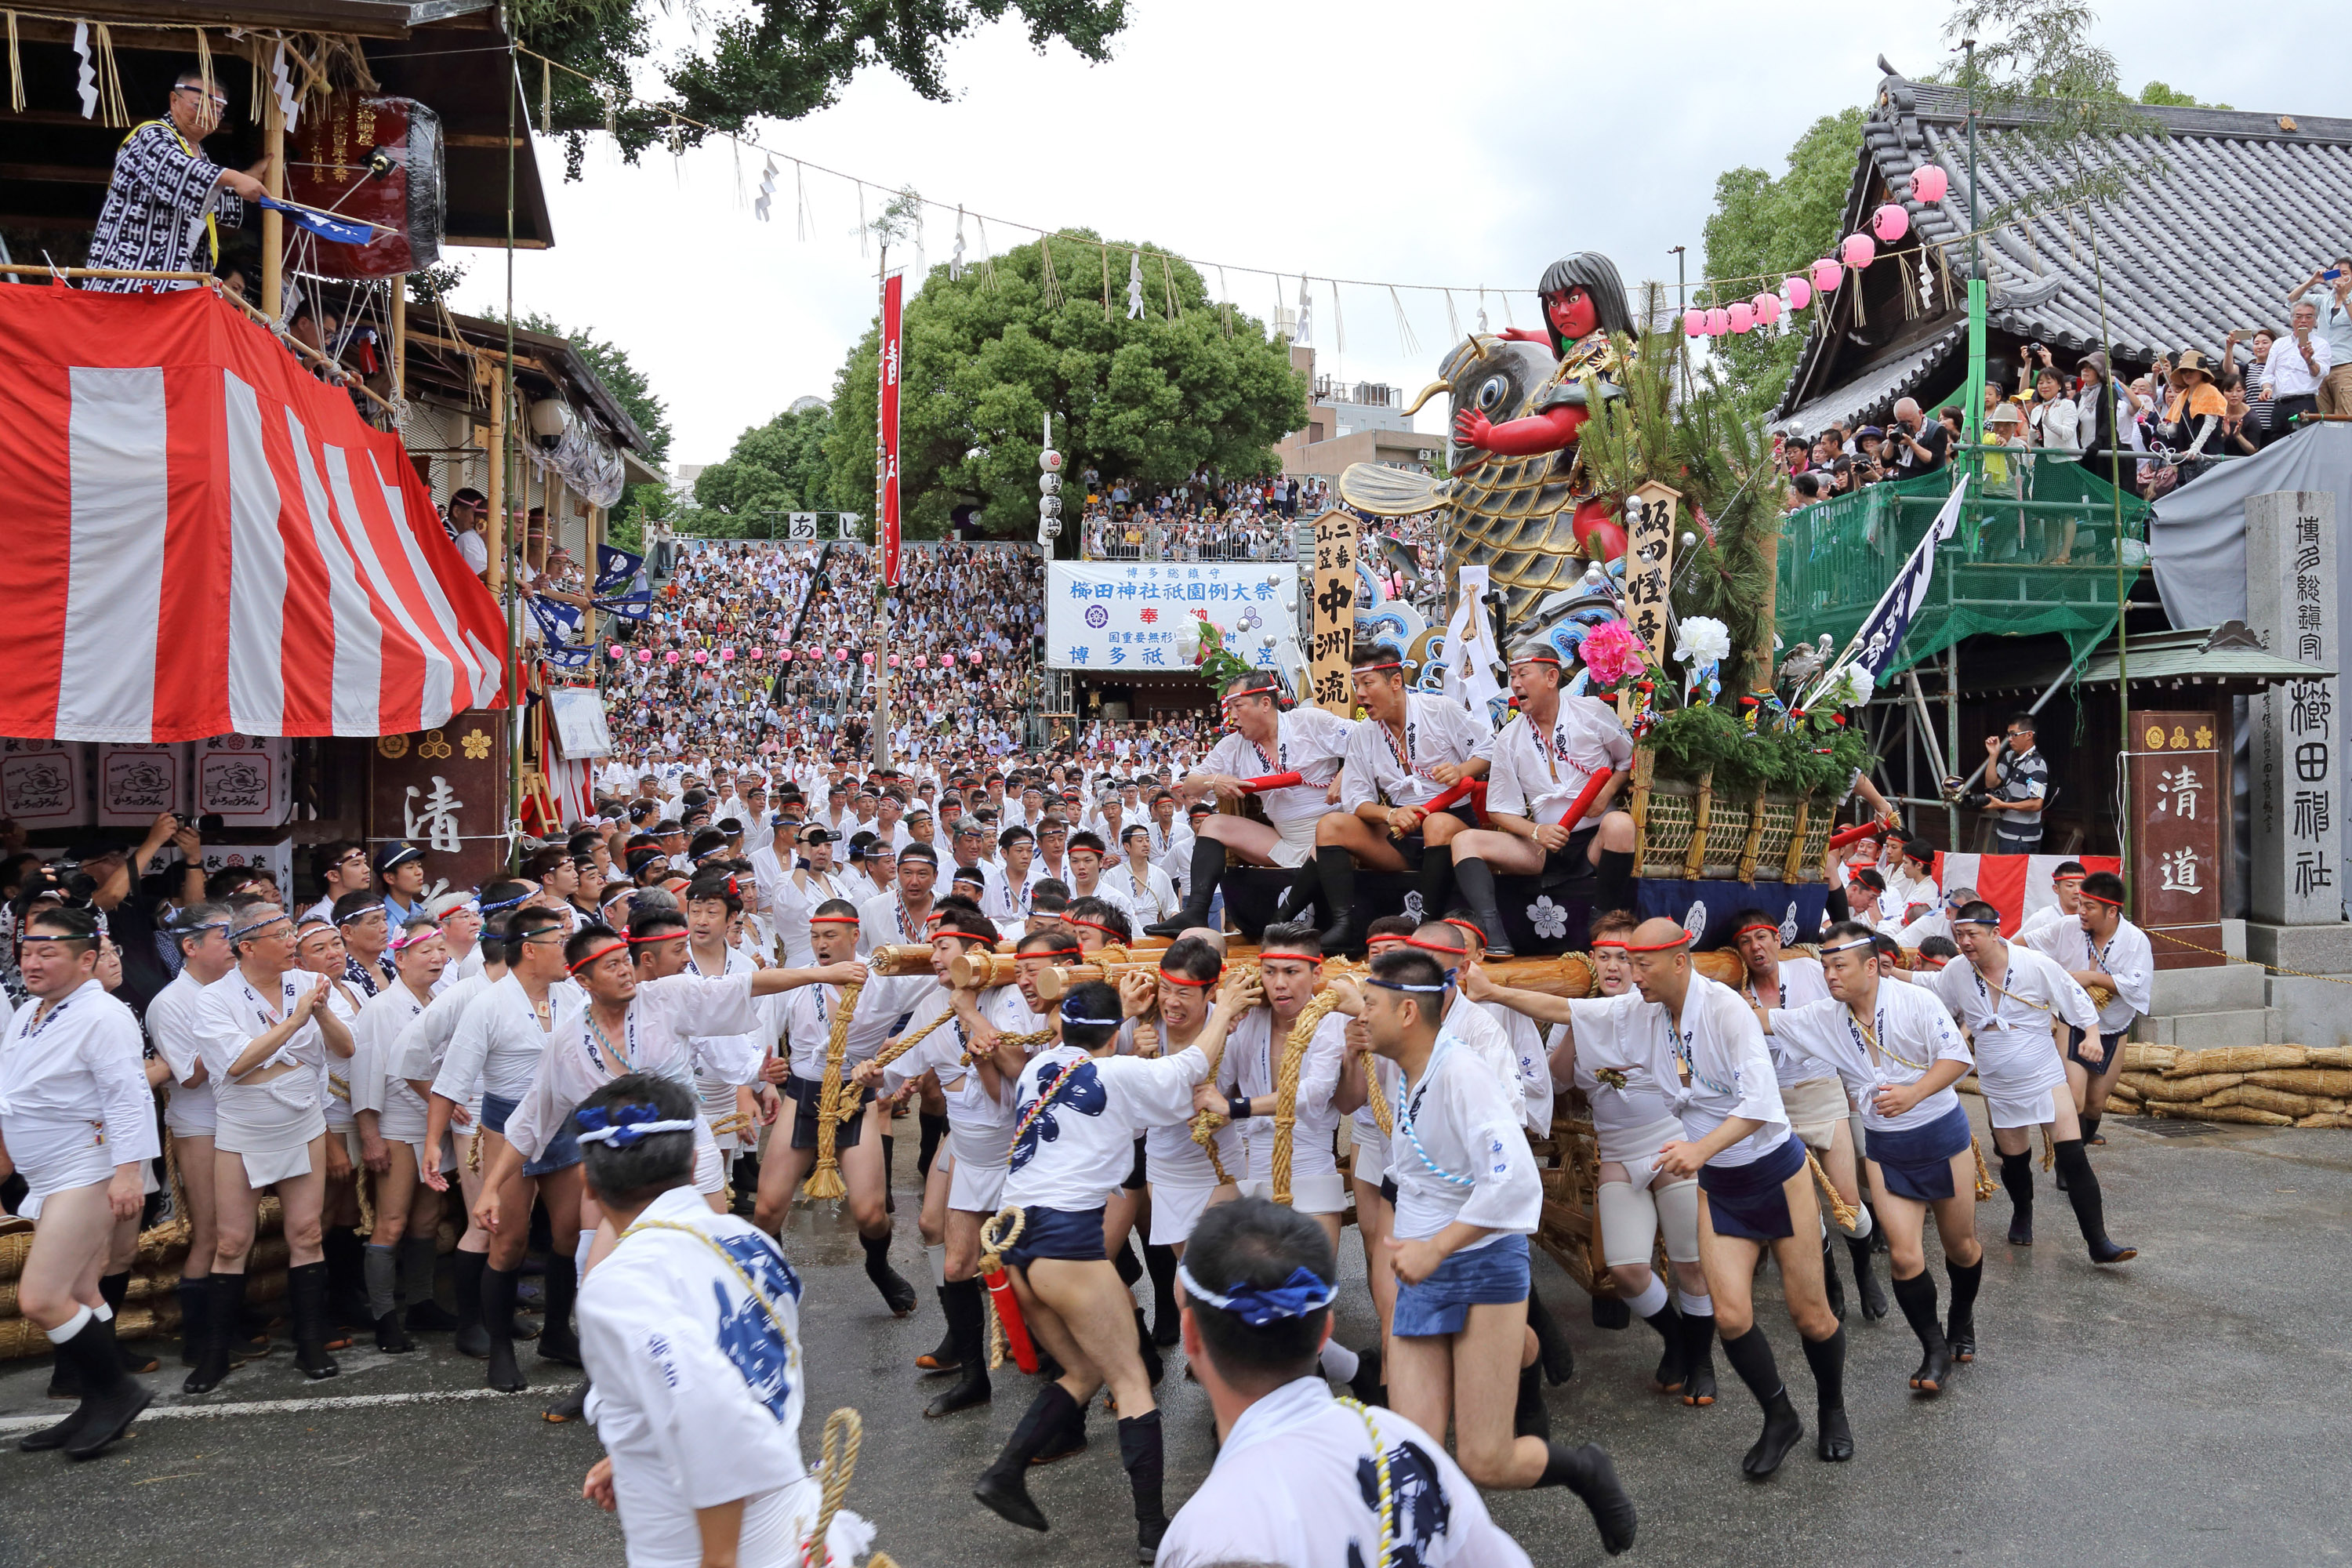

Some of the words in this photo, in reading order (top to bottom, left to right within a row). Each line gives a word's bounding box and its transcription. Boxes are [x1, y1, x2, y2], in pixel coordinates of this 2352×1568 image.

[792, 514, 815, 538] あ
[1316, 524, 1333, 570] 山笠
[1334, 523, 1352, 569] 二番
[1126, 567, 1221, 579] 博多総鎮守
[1069, 580, 1276, 601] 櫛田神社祇園例大祭
[1108, 630, 1237, 644] 国重要無形財
[1315, 578, 1352, 705] 中洲流
[1068, 645, 1276, 666] 博多祇笠
[2157, 765, 2204, 895] 清道
